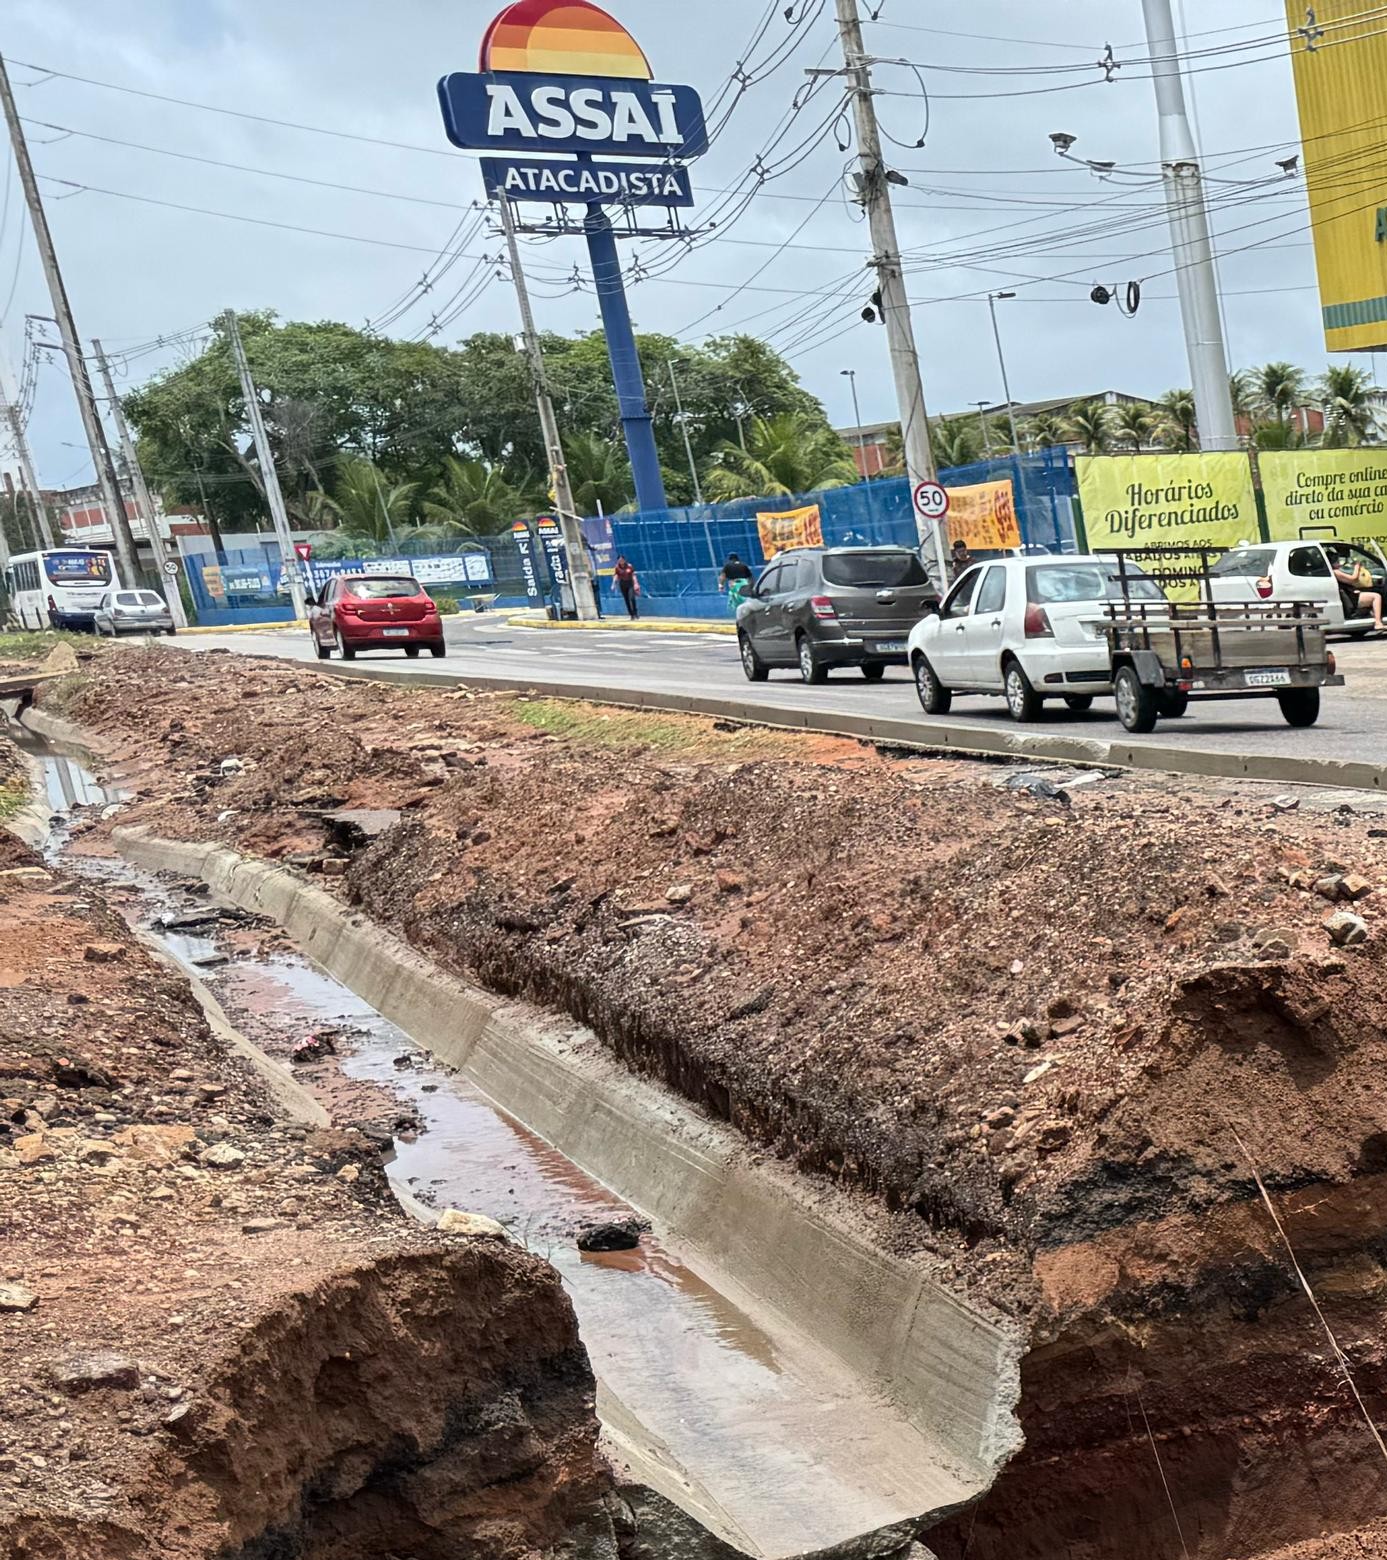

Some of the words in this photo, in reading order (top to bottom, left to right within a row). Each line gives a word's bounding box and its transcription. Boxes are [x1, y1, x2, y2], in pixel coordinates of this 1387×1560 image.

[485, 84, 684, 144] ASSAÍ
[505, 167, 683, 196] ATACADISTA
[1297, 472, 1346, 490] Compre
[1349, 466, 1387, 483] online
[920, 491, 943, 506] 50
[1126, 478, 1214, 506] Horários
[1285, 490, 1323, 506] direto
[1327, 487, 1344, 502] da
[1348, 487, 1371, 500] sua
[1105, 501, 1240, 539] Diferenciados
[1309, 508, 1325, 520] ou
[1328, 499, 1384, 518] comércio
